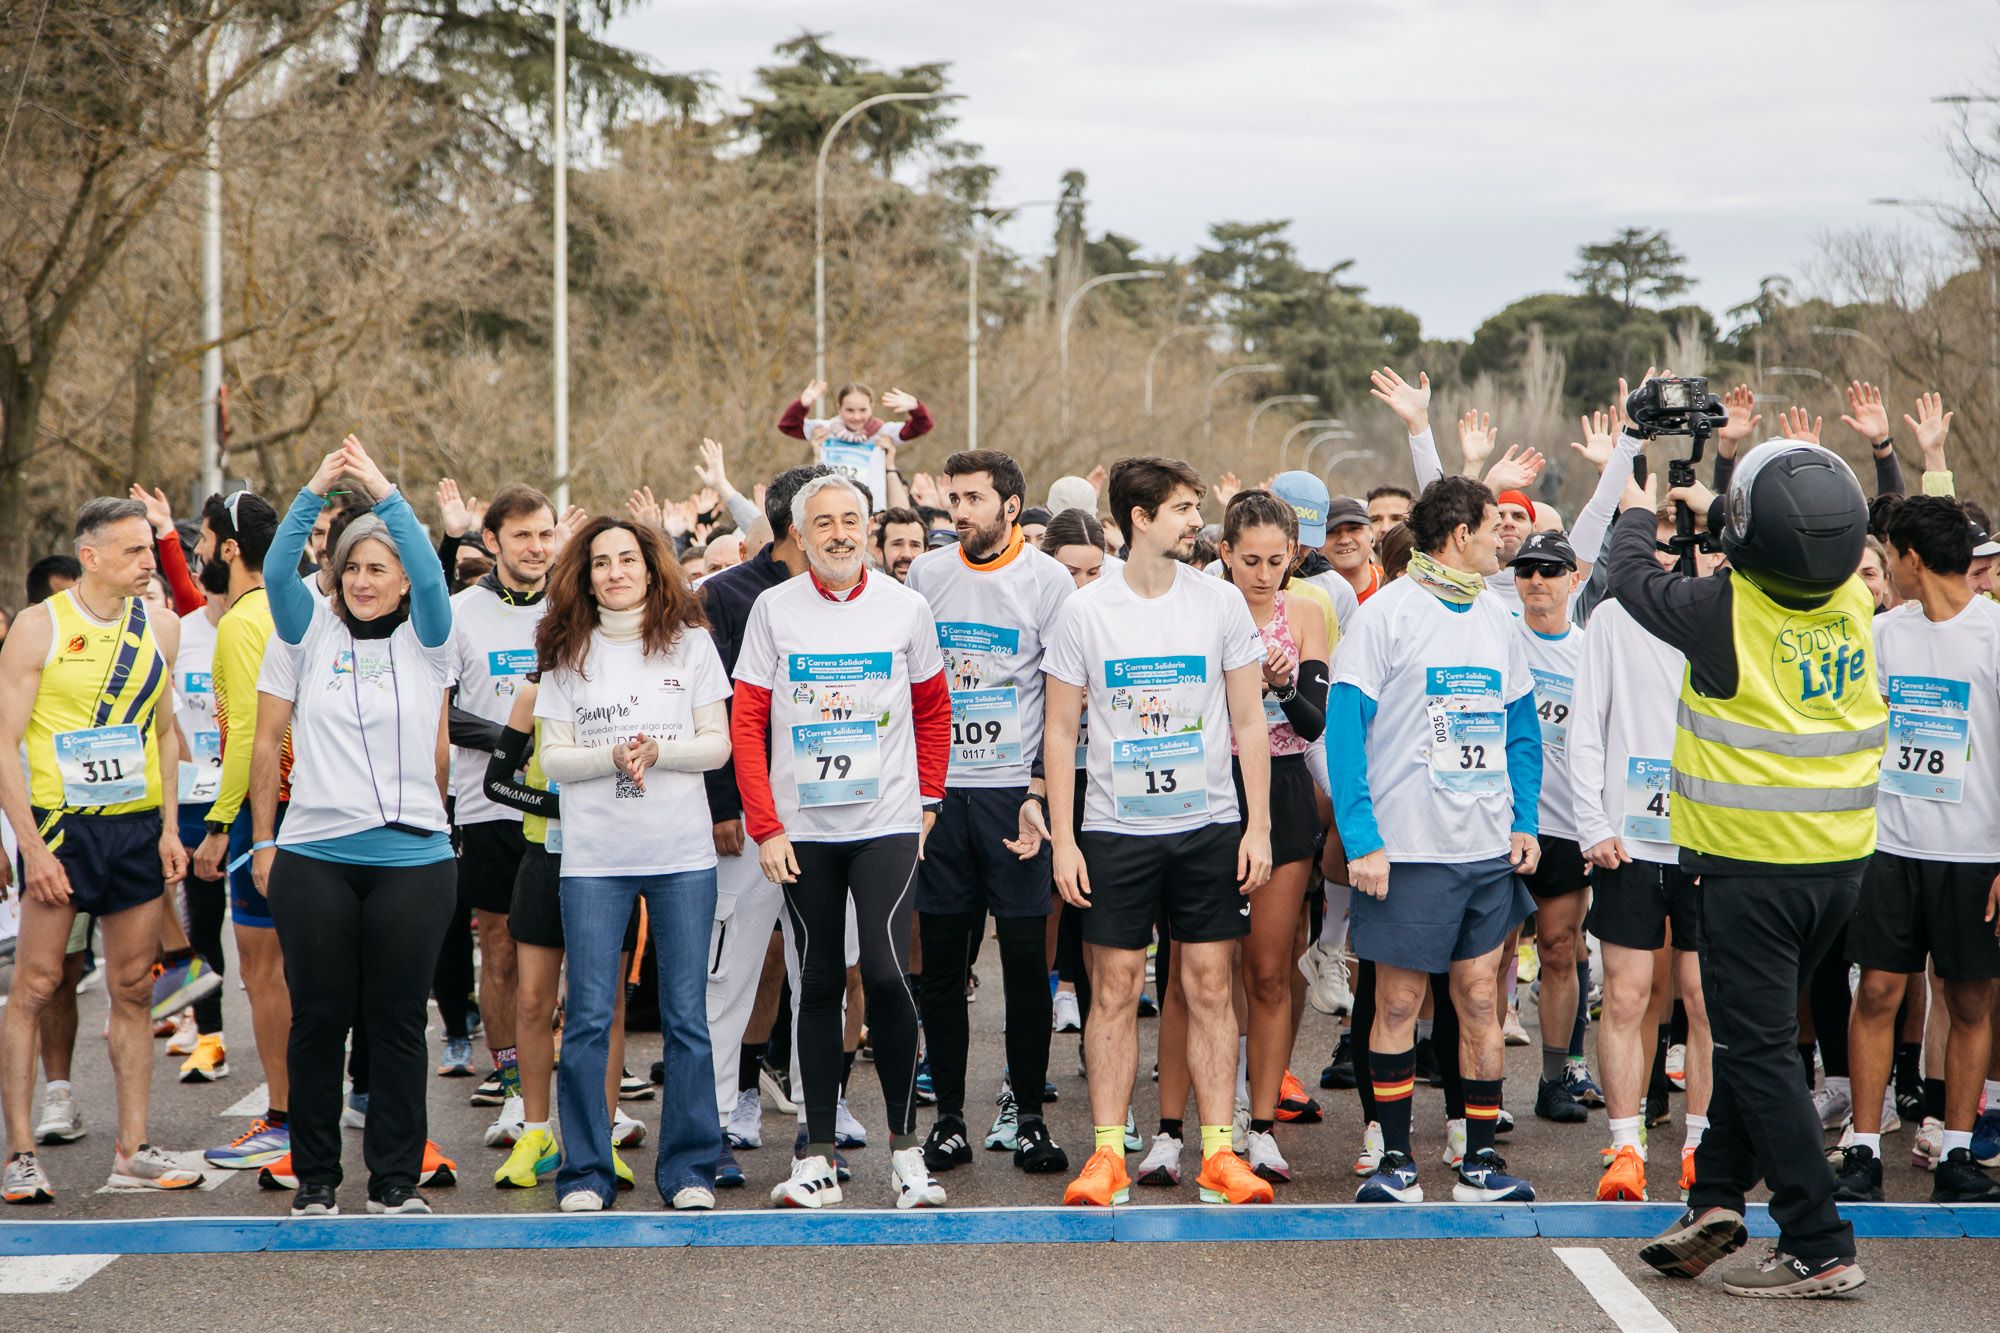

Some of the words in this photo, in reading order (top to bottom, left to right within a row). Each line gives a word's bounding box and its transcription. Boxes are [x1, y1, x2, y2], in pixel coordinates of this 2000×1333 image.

[1293, 505, 1318, 520] OKA
[1780, 616, 1851, 664] Sport
[990, 645, 1013, 655] 2026
[807, 659, 837, 667] Carrera
[839, 658, 873, 666] Solidaria
[1125, 663, 1153, 672] Carrera
[1155, 661, 1185, 669] Solidaria
[864, 671, 887, 681] 2026
[1178, 675, 1202, 684] 2026
[1799, 644, 1866, 702] Life
[1901, 681, 1924, 690] Carrera
[951, 696, 974, 704] Carrera
[975, 695, 1003, 703] Solidaria
[576, 703, 630, 725] Siempre
[1537, 700, 1569, 725] 49
[588, 725, 613, 737] puede
[614, 723, 638, 732] hacer
[640, 721, 660, 732] algo
[806, 729, 832, 737] Carrera
[832, 727, 864, 735] Solidaria
[952, 720, 1001, 744] 109
[1433, 715, 1447, 743] 0035
[962, 749, 985, 759] 0117
[1132, 745, 1158, 753] Carrera
[1160, 740, 1190, 750] Solidaria
[1460, 745, 1486, 770] 32
[1898, 745, 1945, 775] 378
[82, 758, 124, 783] 311
[816, 754, 852, 780] 79
[1647, 765, 1670, 773] Carrer
[1145, 768, 1177, 794] 13
